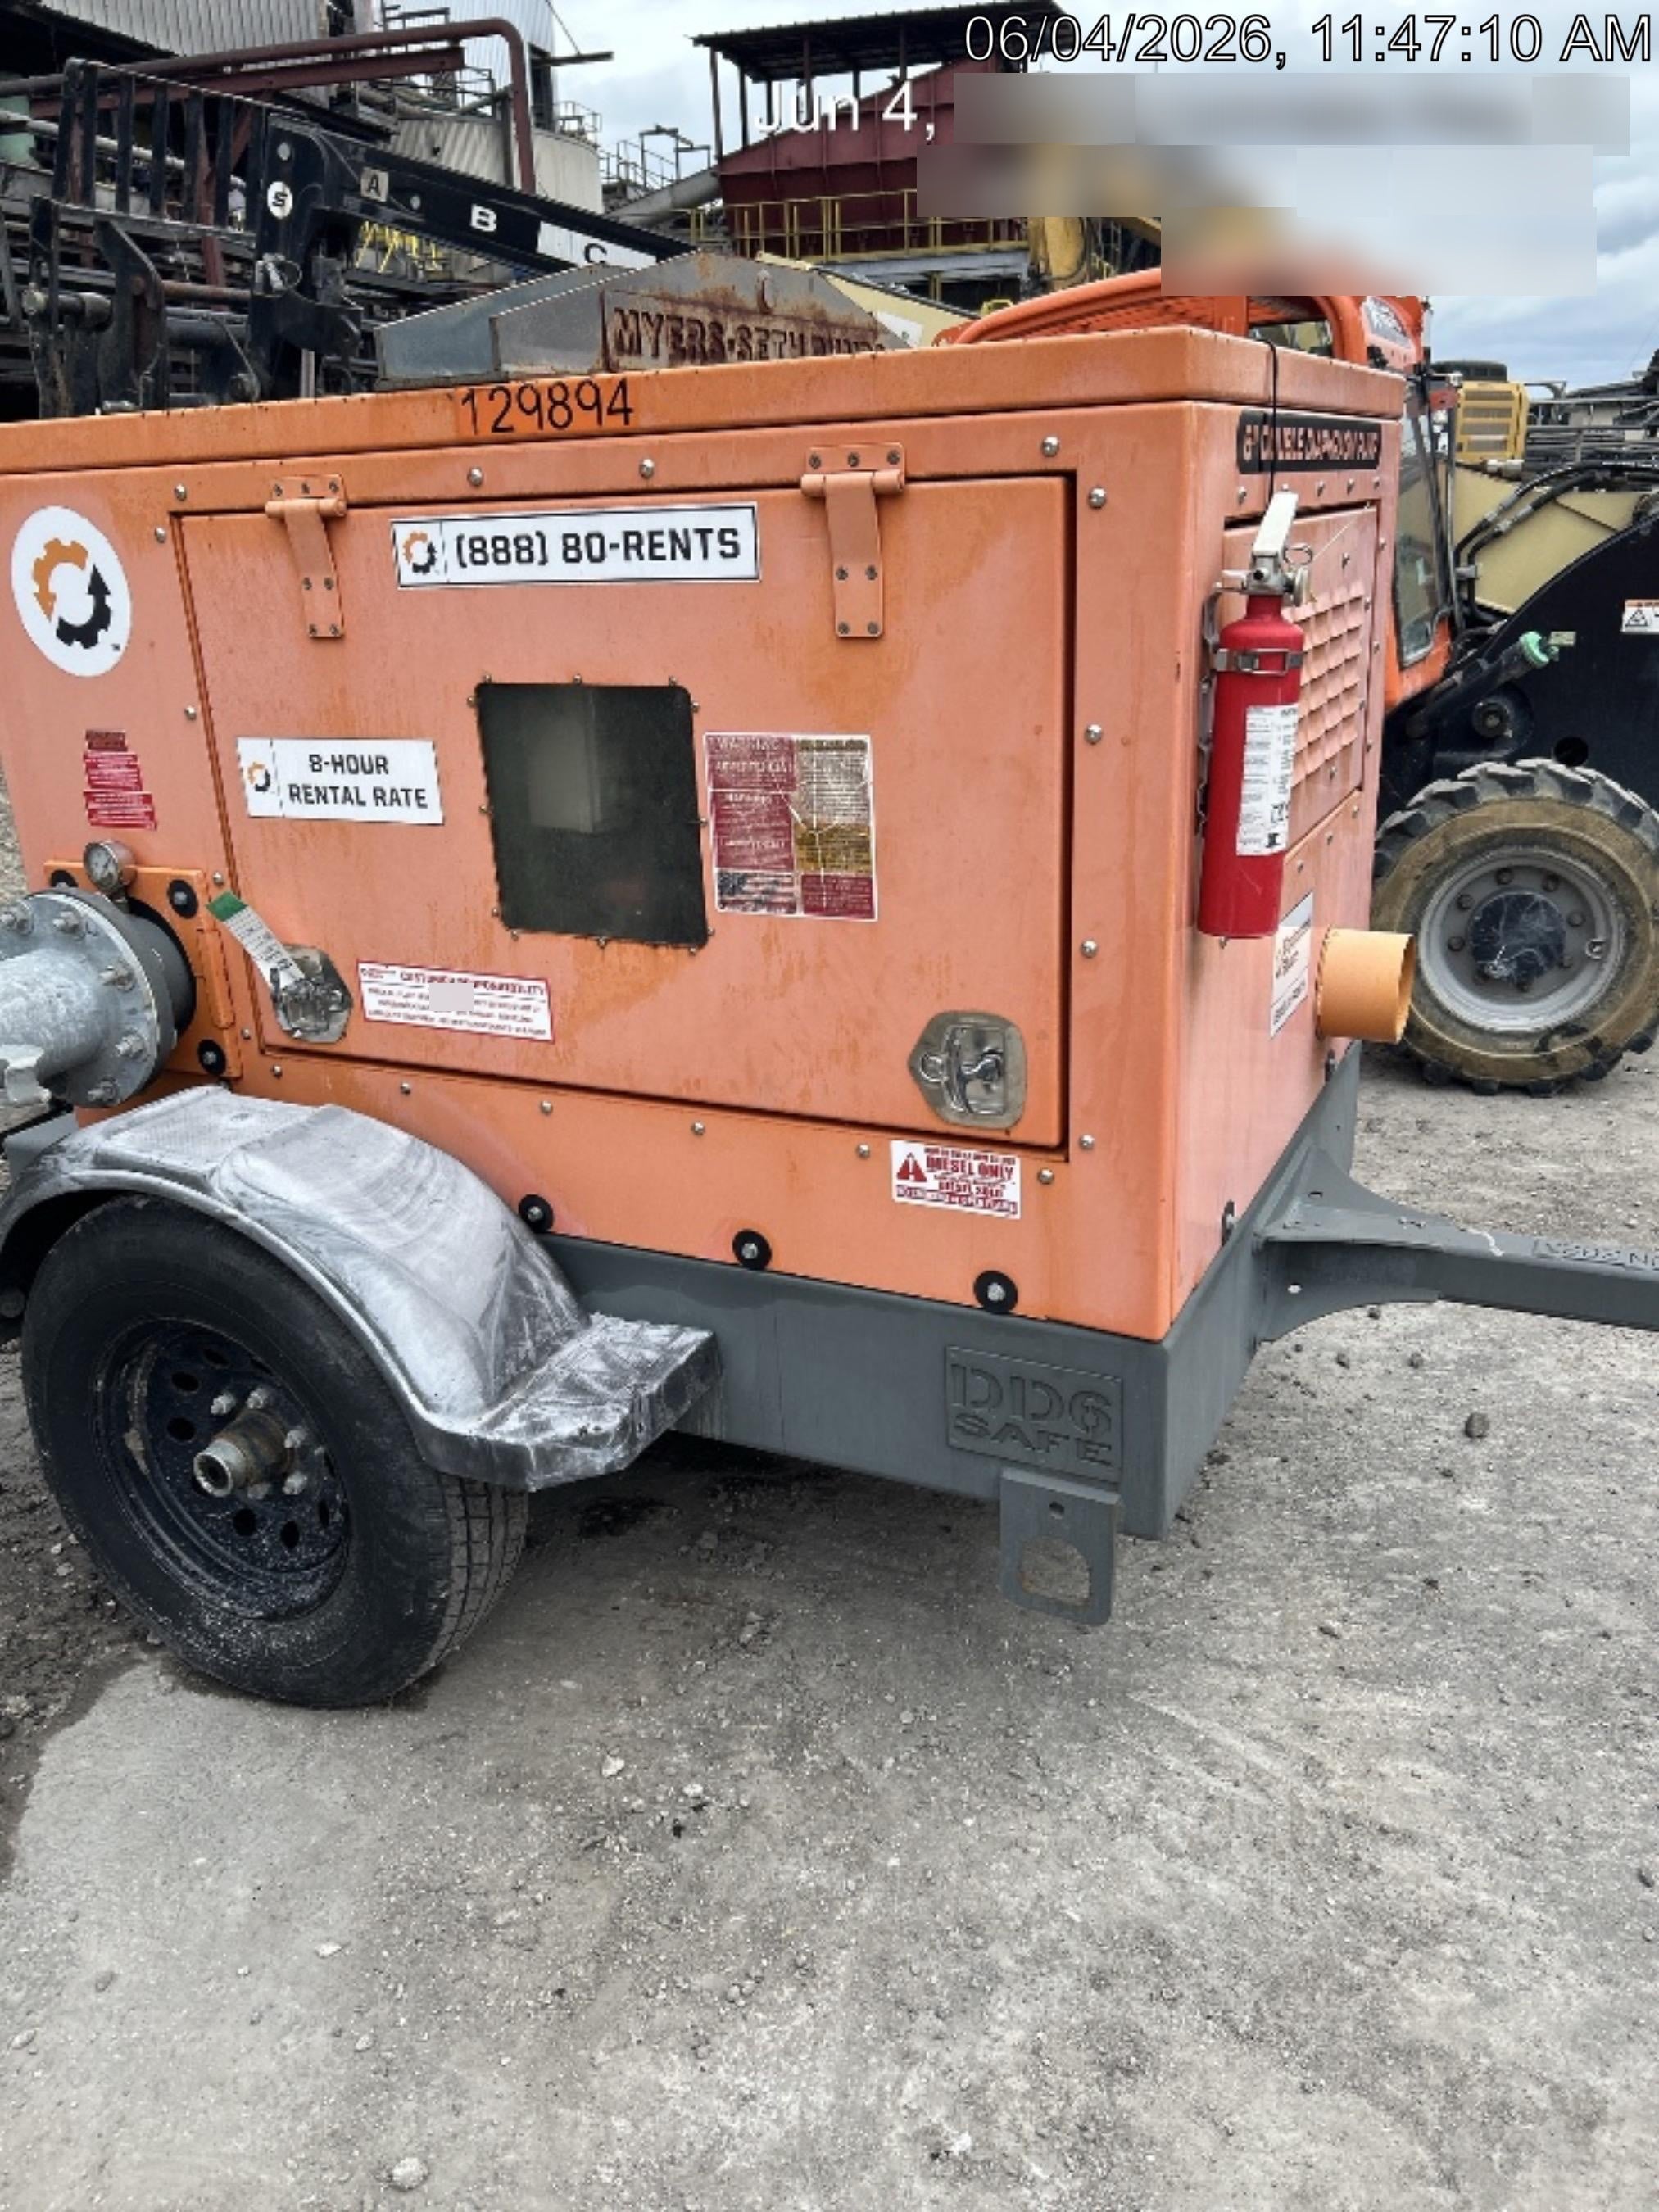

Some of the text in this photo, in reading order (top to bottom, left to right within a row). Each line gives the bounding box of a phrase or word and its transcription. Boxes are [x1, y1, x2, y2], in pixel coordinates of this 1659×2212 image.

[366, 174, 381, 197] A
[471, 204, 496, 233] B
[461, 378, 634, 435] 129894
[456, 530, 548, 569] (888)
[309, 753, 389, 776] 8-HOUR
[288, 782, 428, 809] RENTAL RATE
[926, 1154, 975, 1176] DIESEL
[977, 1163, 1014, 1181] ONLY
[954, 1412, 1114, 1467] SAFE
